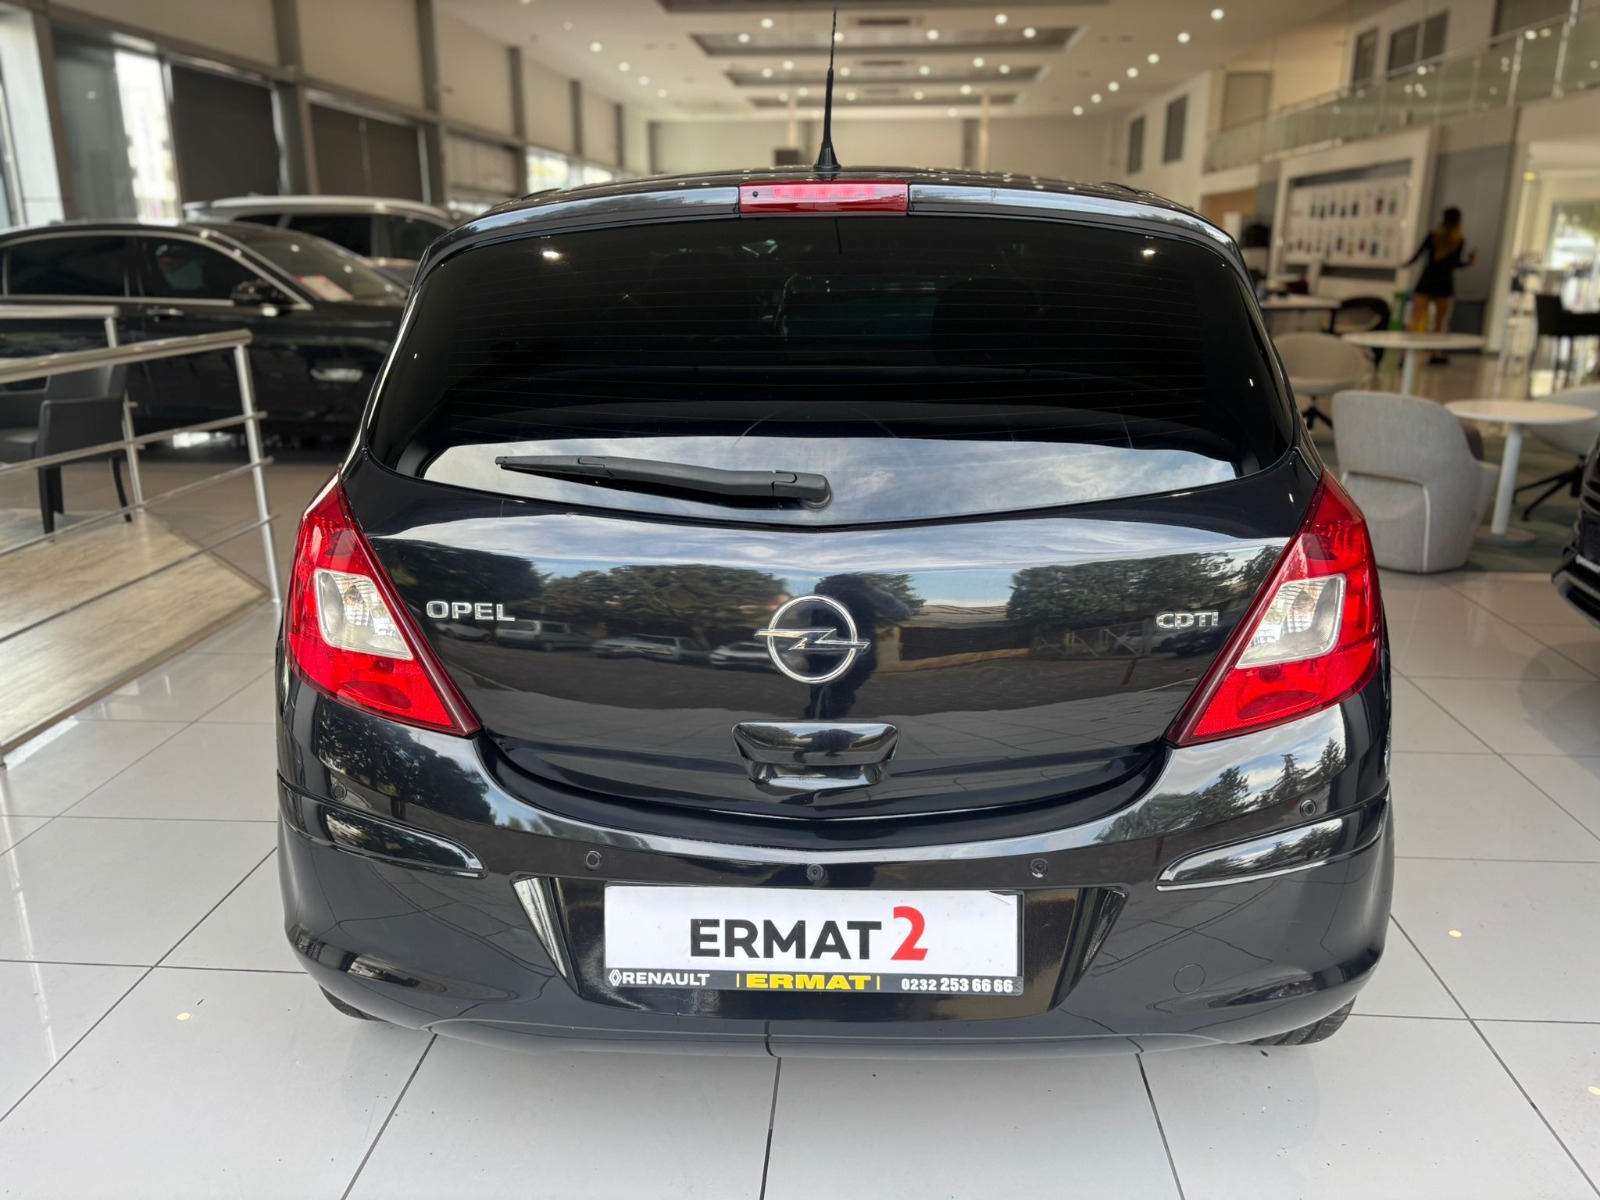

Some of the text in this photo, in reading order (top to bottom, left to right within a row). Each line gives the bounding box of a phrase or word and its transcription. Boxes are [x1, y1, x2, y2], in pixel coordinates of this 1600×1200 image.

[426, 600, 515, 622] OPEL
[1156, 611, 1219, 629] CDTI
[690, 905, 929, 962] ERMAT 2
[622, 971, 710, 986] RENAULT
[746, 973, 871, 990] ERMAT
[901, 977, 1013, 993] 0232 253 66 66
